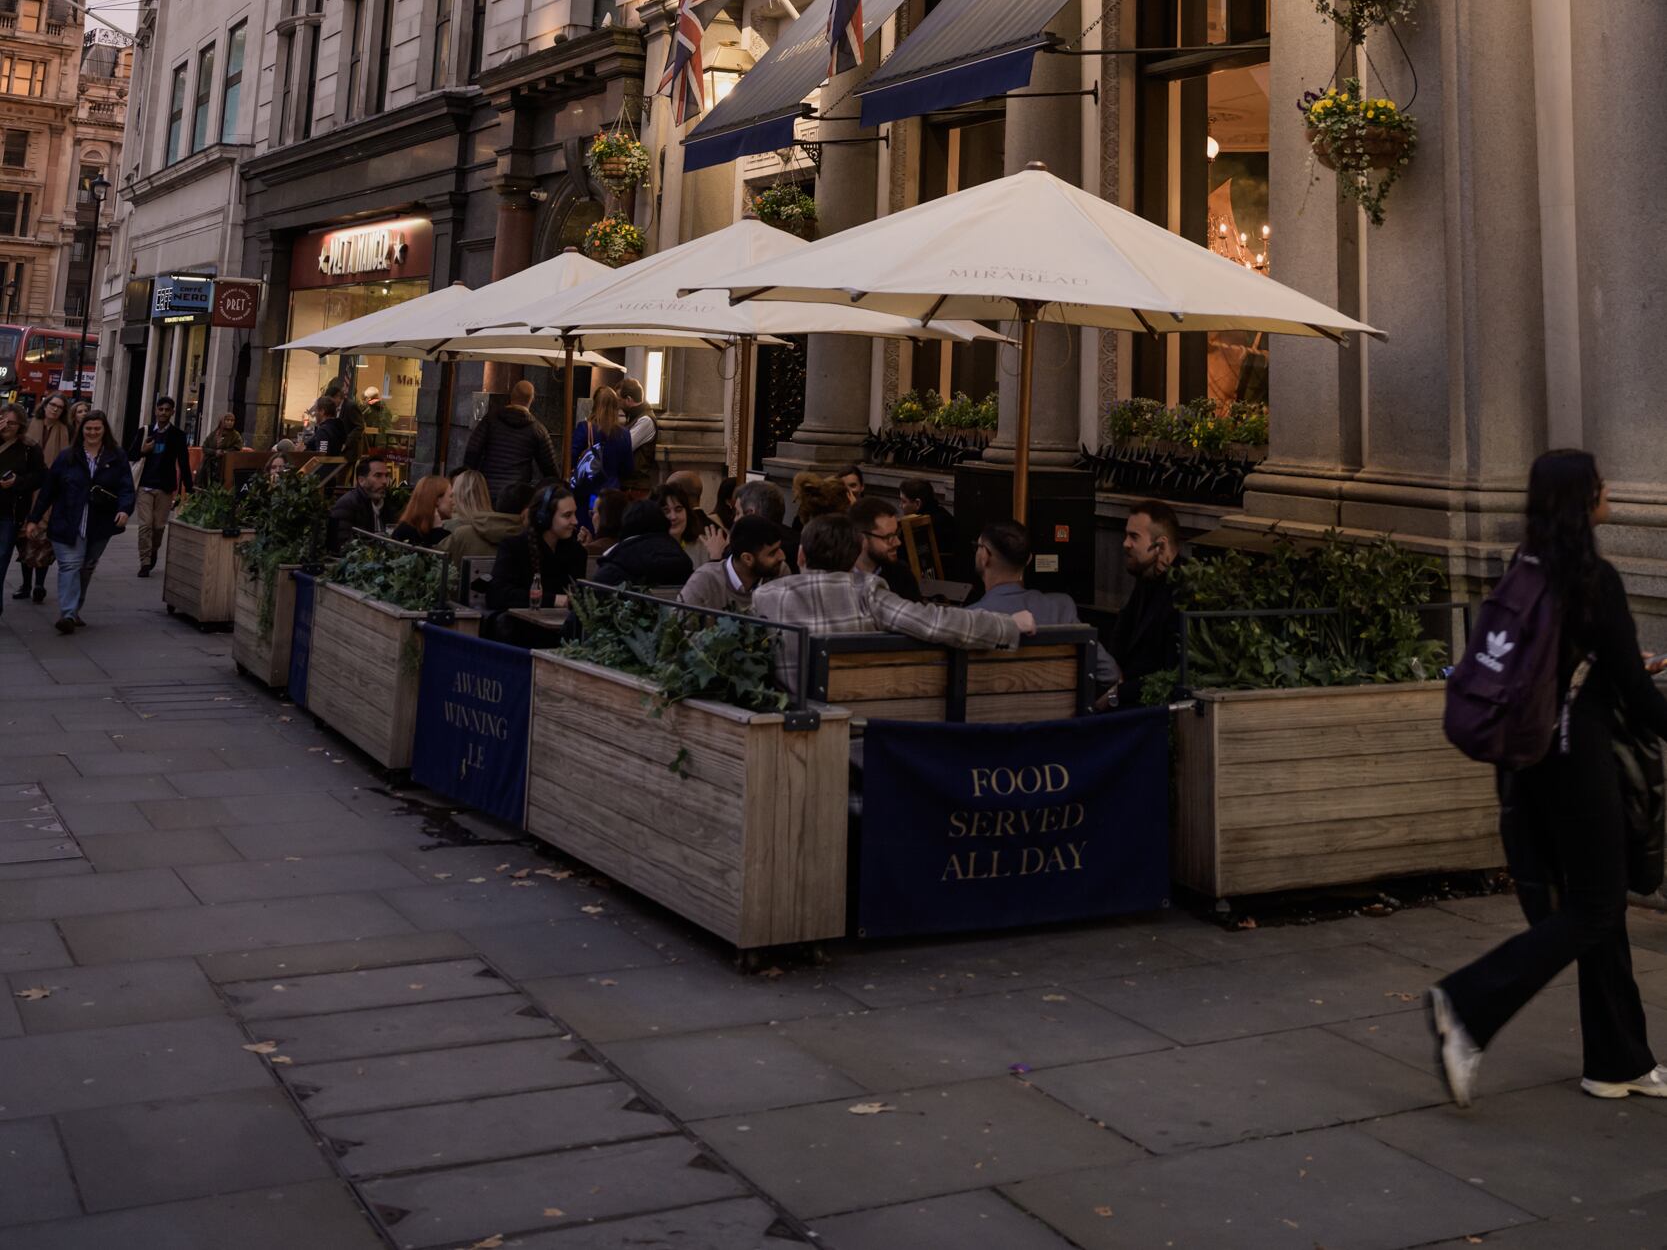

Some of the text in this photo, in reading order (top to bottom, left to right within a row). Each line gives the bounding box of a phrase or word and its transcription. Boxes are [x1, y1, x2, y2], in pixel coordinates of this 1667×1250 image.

[948, 268, 1089, 286] MIRABEAU
[173, 293, 208, 302] NERO
[226, 298, 246, 311] PRET
[452, 671, 503, 703] AWARD
[443, 700, 508, 741] WINNING
[970, 763, 1070, 797] FOOD
[948, 802, 1085, 838] SERVED
[940, 840, 1088, 882] ALL DAY
